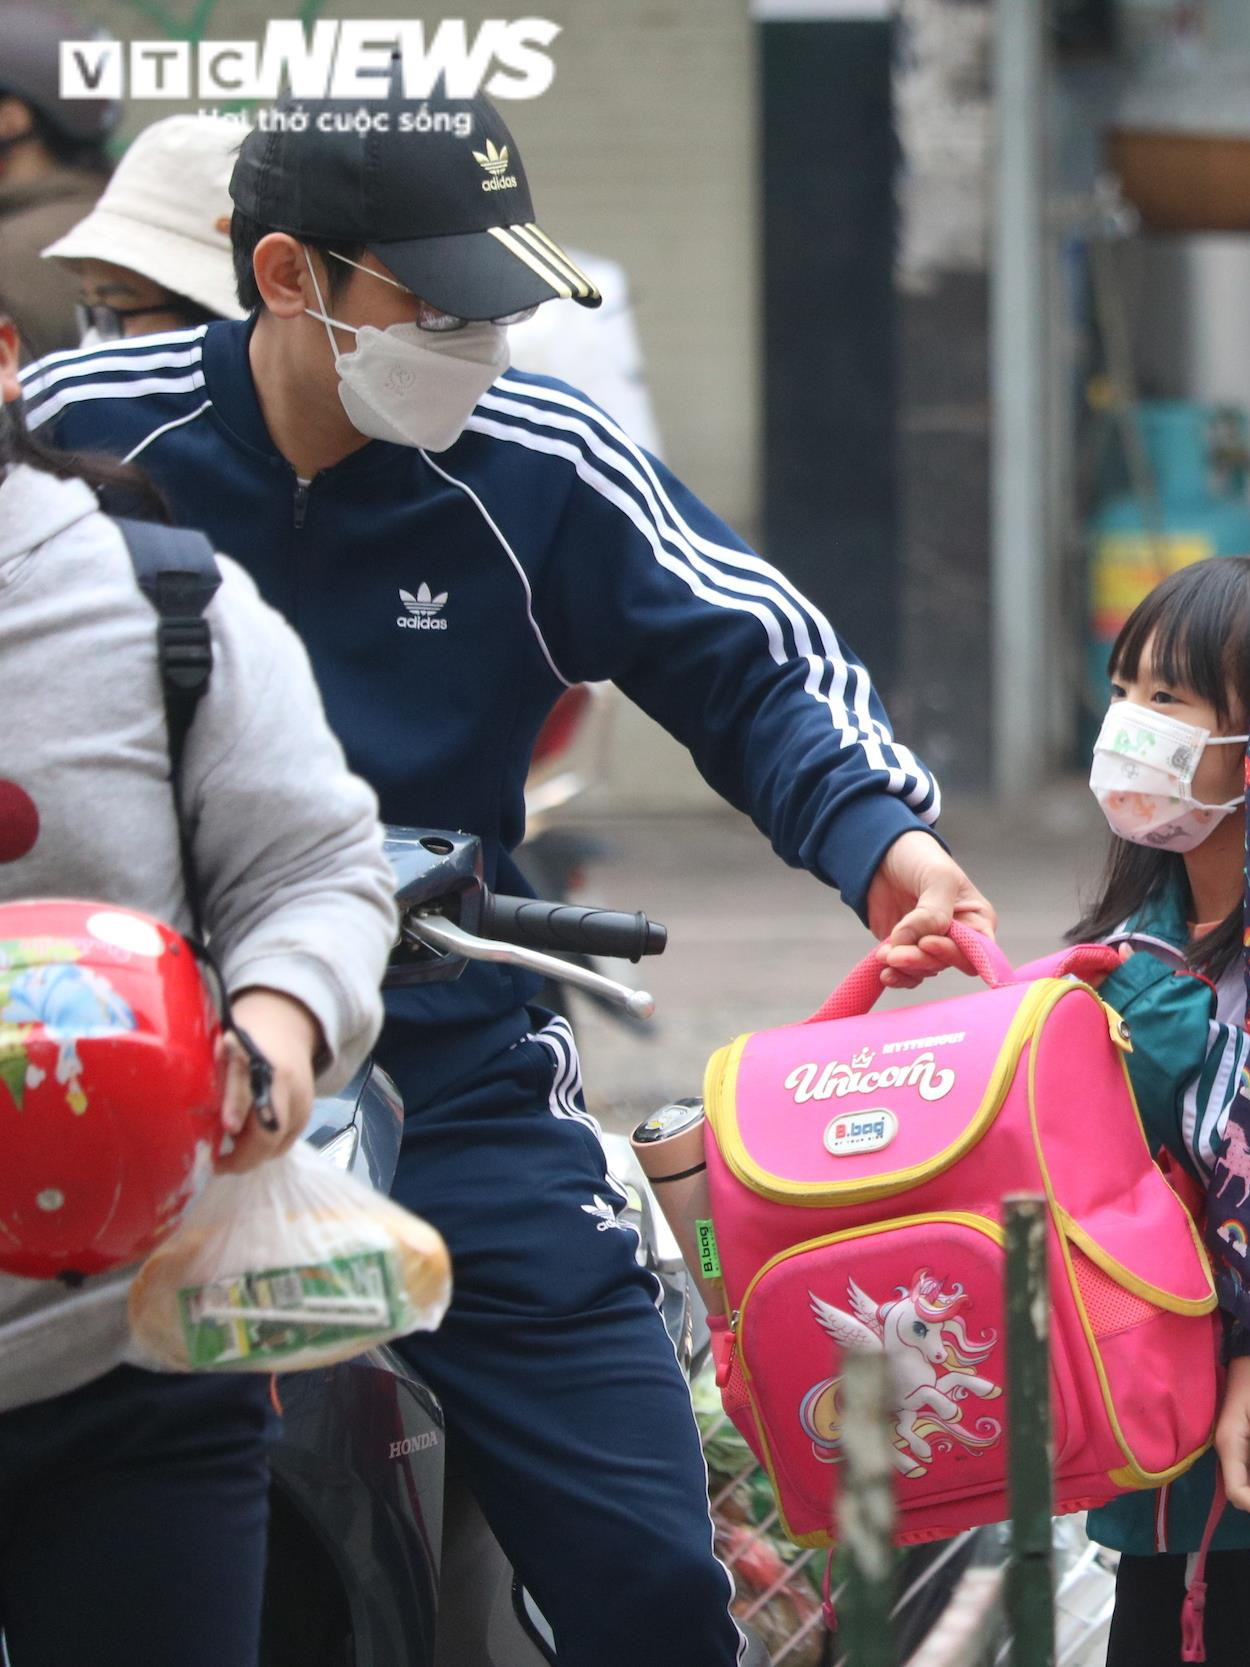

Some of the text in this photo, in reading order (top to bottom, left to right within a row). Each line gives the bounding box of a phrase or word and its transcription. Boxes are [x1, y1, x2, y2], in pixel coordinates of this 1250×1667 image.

[481, 175, 518, 192] adidas
[396, 615, 448, 630] adidas
[784, 1052, 956, 1104] Unicorn
[835, 1121, 884, 1139] B.bag
[699, 1226, 713, 1272] B.bag
[388, 1431, 438, 1459] HONDA
